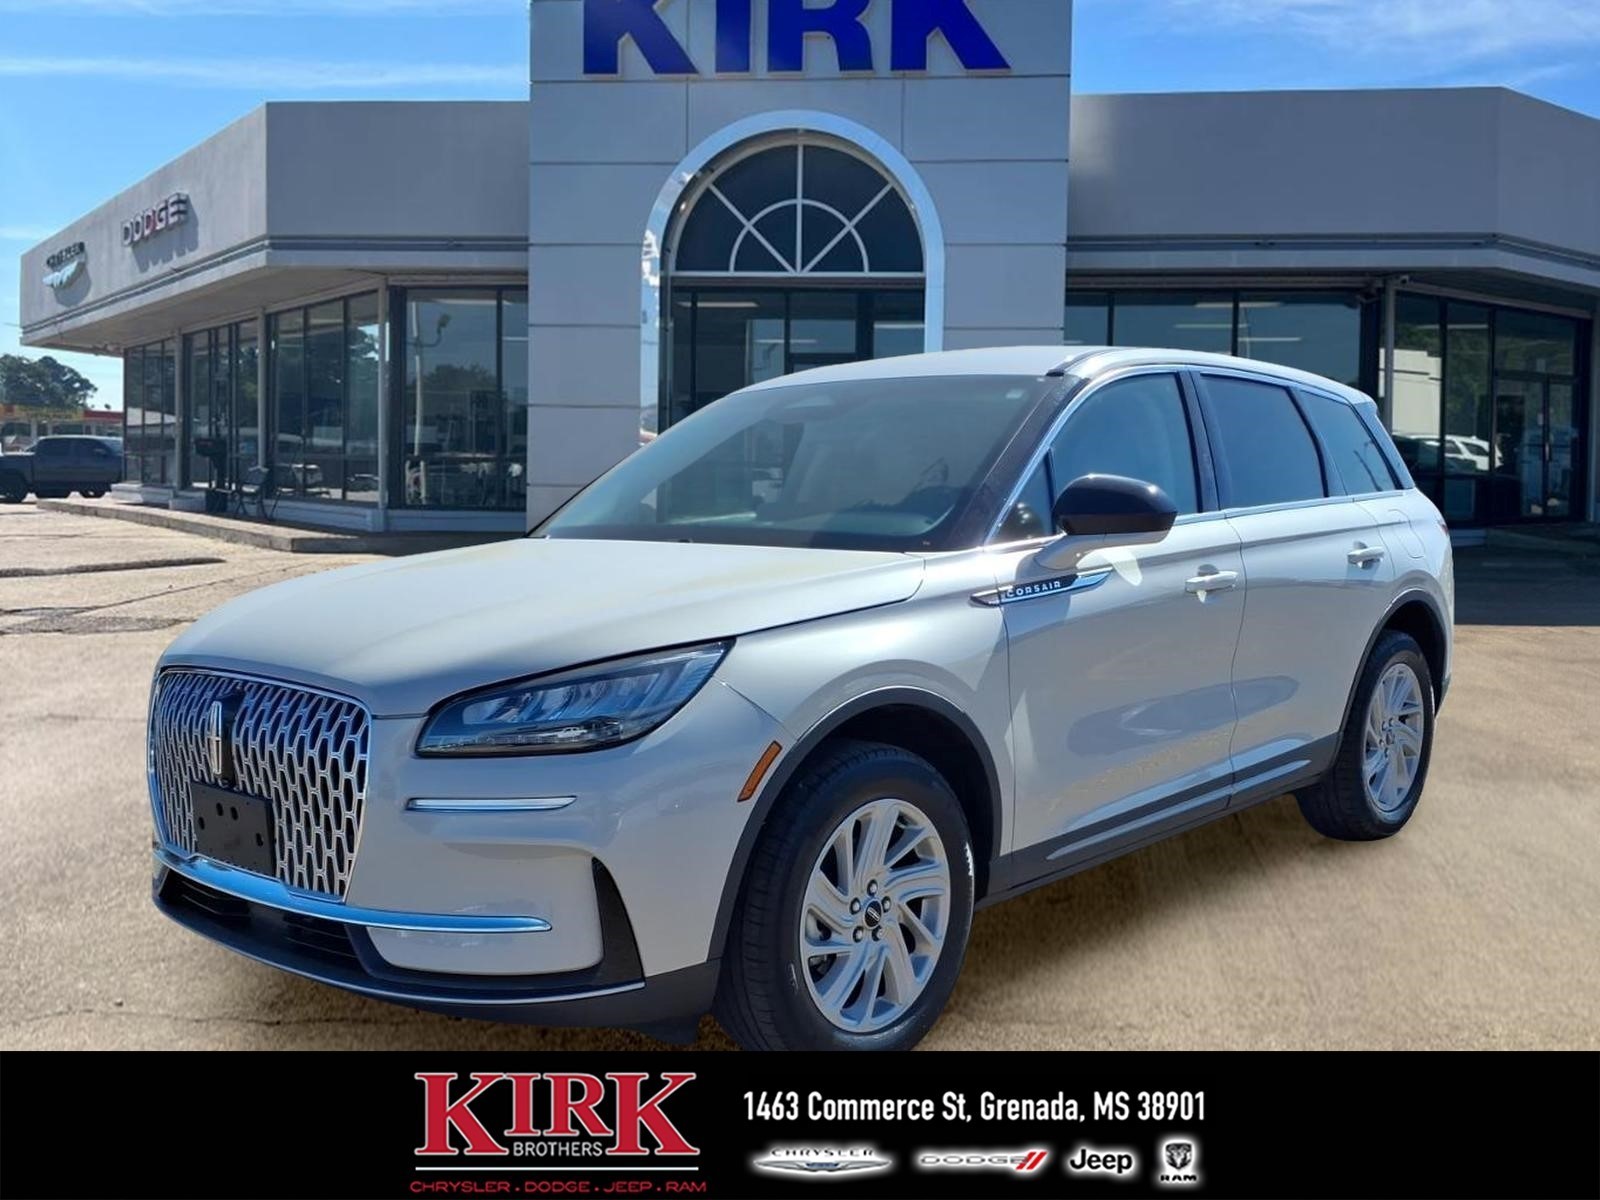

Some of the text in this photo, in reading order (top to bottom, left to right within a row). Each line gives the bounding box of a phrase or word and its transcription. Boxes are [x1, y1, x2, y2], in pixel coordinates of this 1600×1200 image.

[583, 0, 1011, 74] KIRK
[121, 193, 189, 247] DODGE
[1006, 581, 1062, 597] CORSAIR
